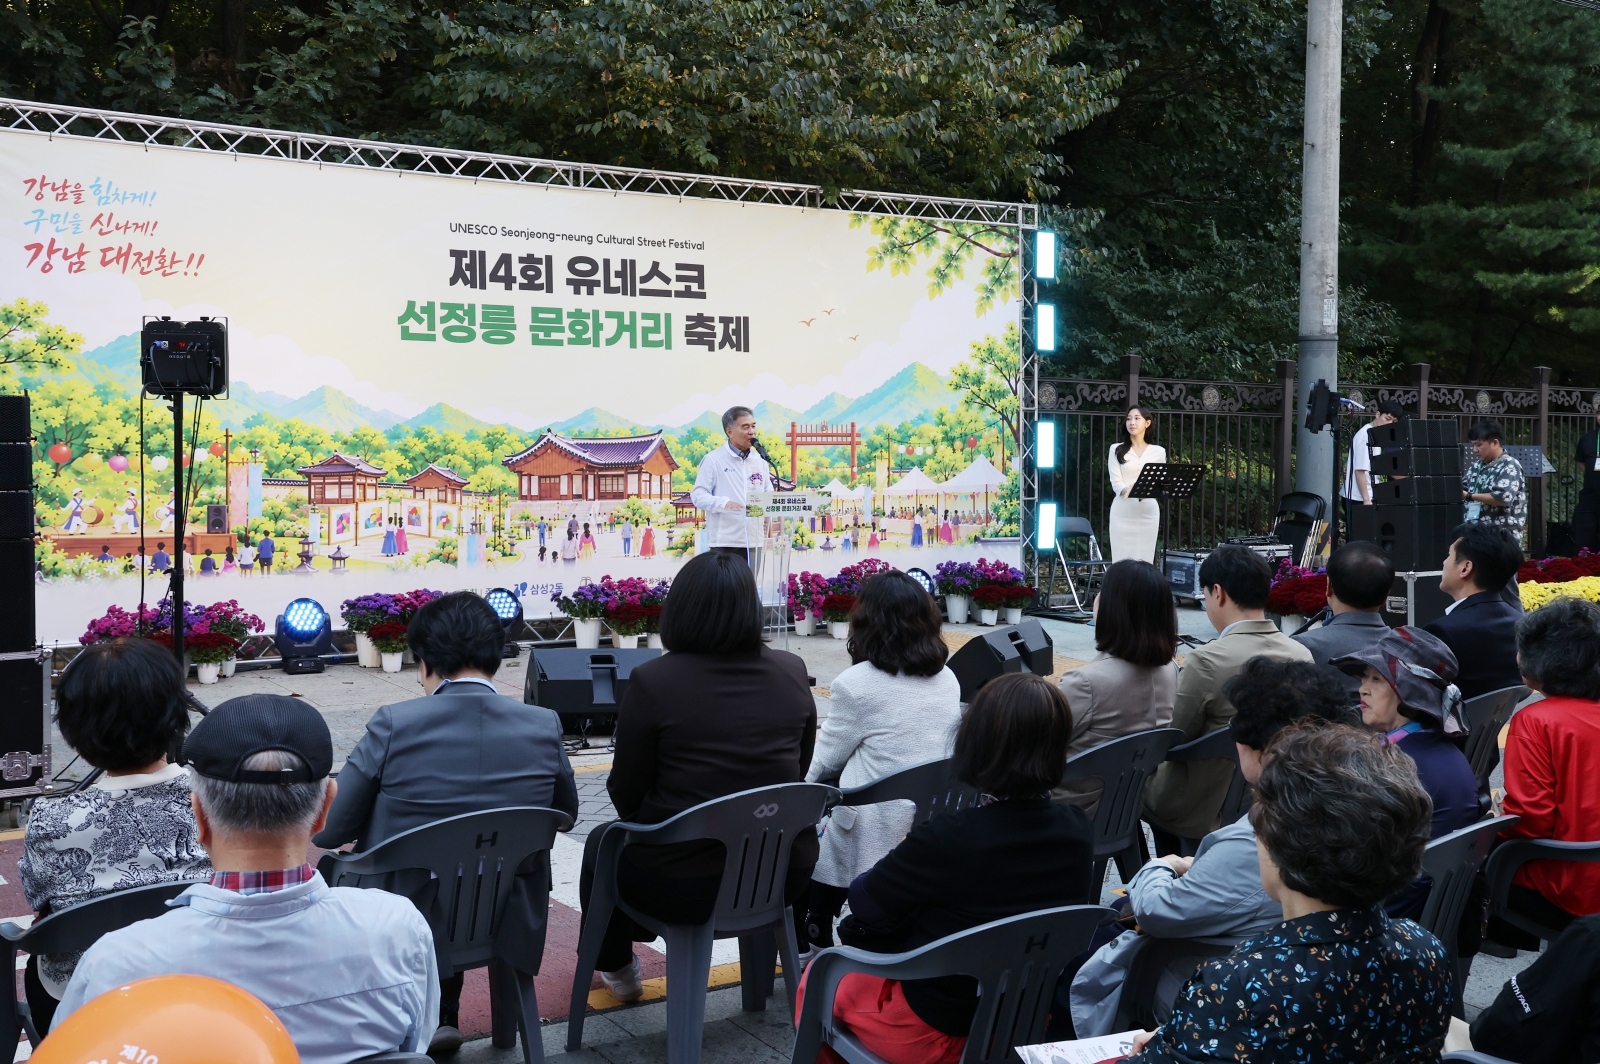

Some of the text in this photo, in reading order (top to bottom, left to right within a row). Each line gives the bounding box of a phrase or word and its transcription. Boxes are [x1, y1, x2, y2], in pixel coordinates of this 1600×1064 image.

[23, 174, 157, 207] 강남을 힘차게!
[23, 208, 158, 237] 구민을 신나게!
[449, 222, 705, 250] UNESCO Seonjeong-neung Cultural Street Festival
[23, 237, 205, 278] 강남 대전환!!
[449, 248, 707, 300] 제4회 유네스코
[397, 300, 750, 353] 선정릉 문화거리 축제
[530, 582, 564, 596] 삼성2동
[475, 831, 498, 849] H
[1024, 933, 1050, 954] H
[1516, 994, 1532, 1014] FACE
